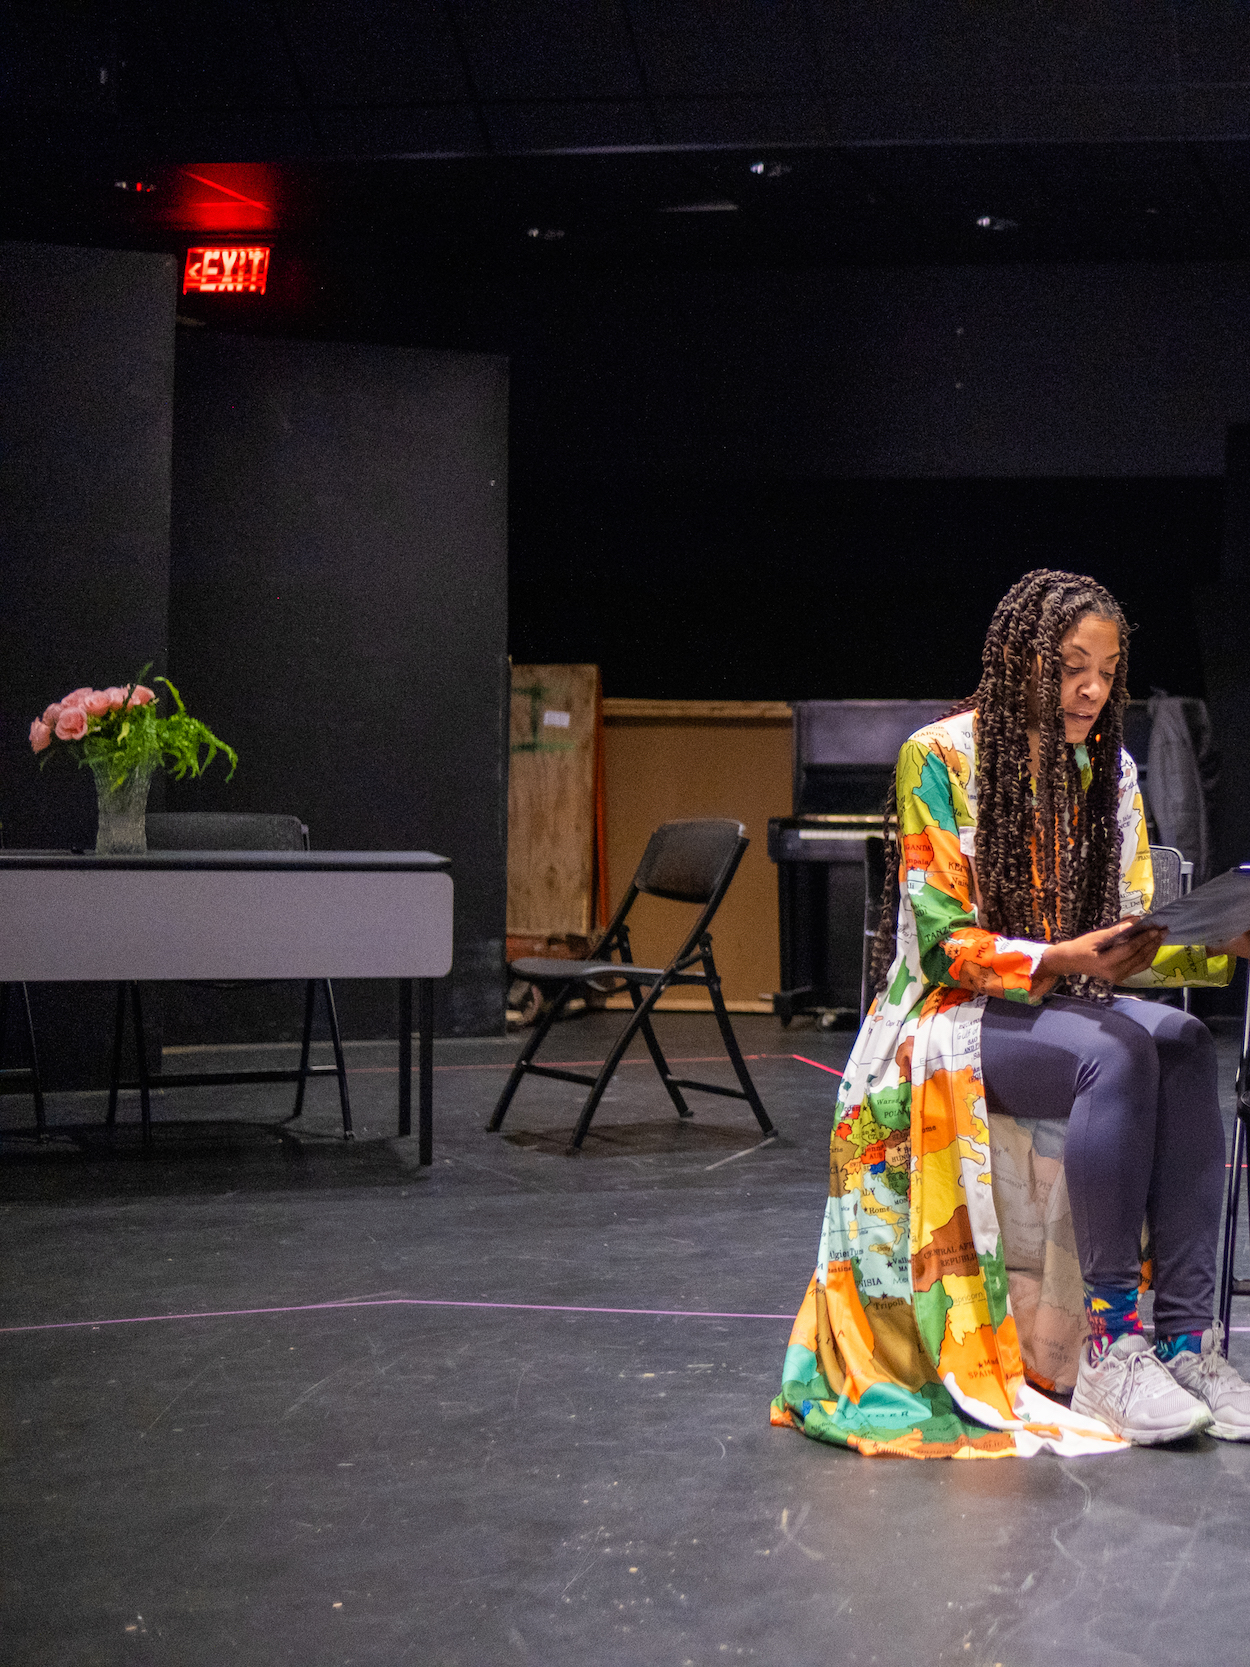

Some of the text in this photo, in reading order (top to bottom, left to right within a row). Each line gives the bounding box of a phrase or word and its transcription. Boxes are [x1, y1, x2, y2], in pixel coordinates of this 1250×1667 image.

[199, 251, 264, 292] EXIT
[869, 1206, 890, 1214] Rome
[874, 1298, 904, 1310] Tripoli
[953, 1292, 983, 1304] apricorn
